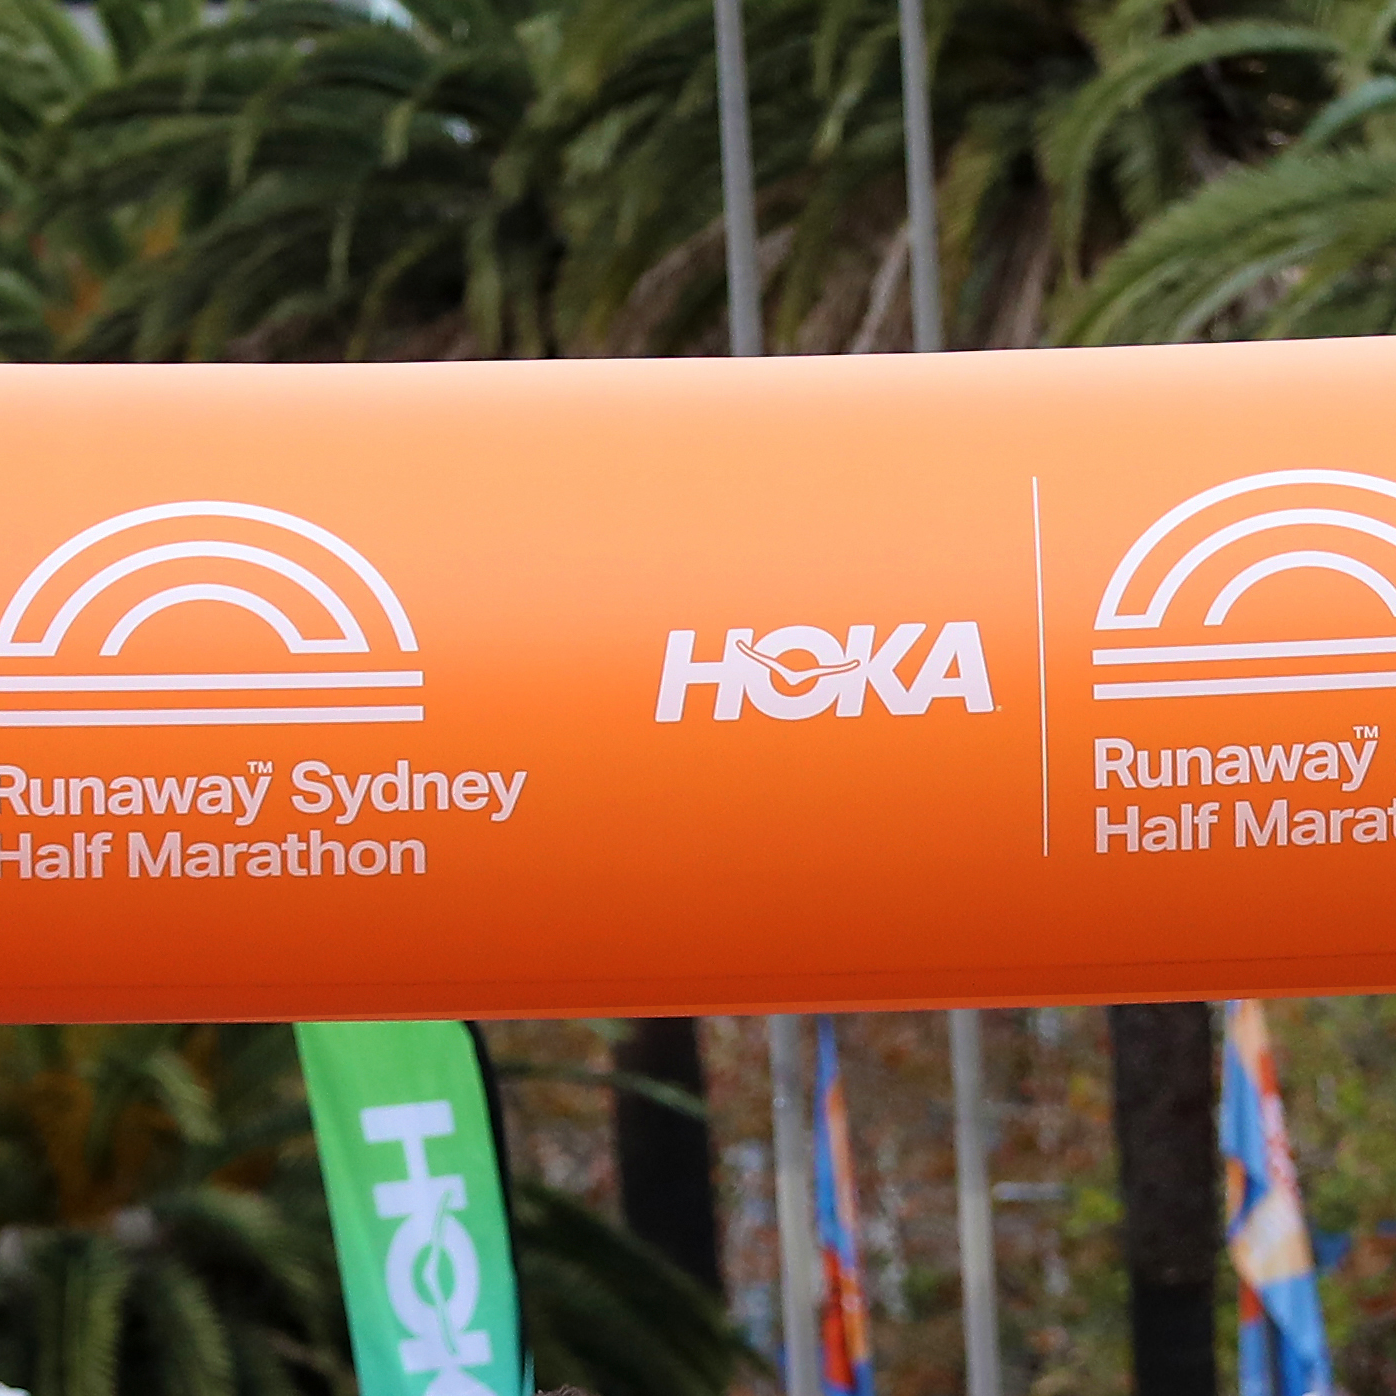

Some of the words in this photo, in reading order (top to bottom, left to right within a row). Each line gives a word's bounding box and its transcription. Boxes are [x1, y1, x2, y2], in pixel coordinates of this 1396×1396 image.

[655, 621, 995, 722] HOKA
[291, 760, 528, 822] Sydney
[127, 828, 426, 878] Marathon
[1094, 802, 1219, 853] Half
